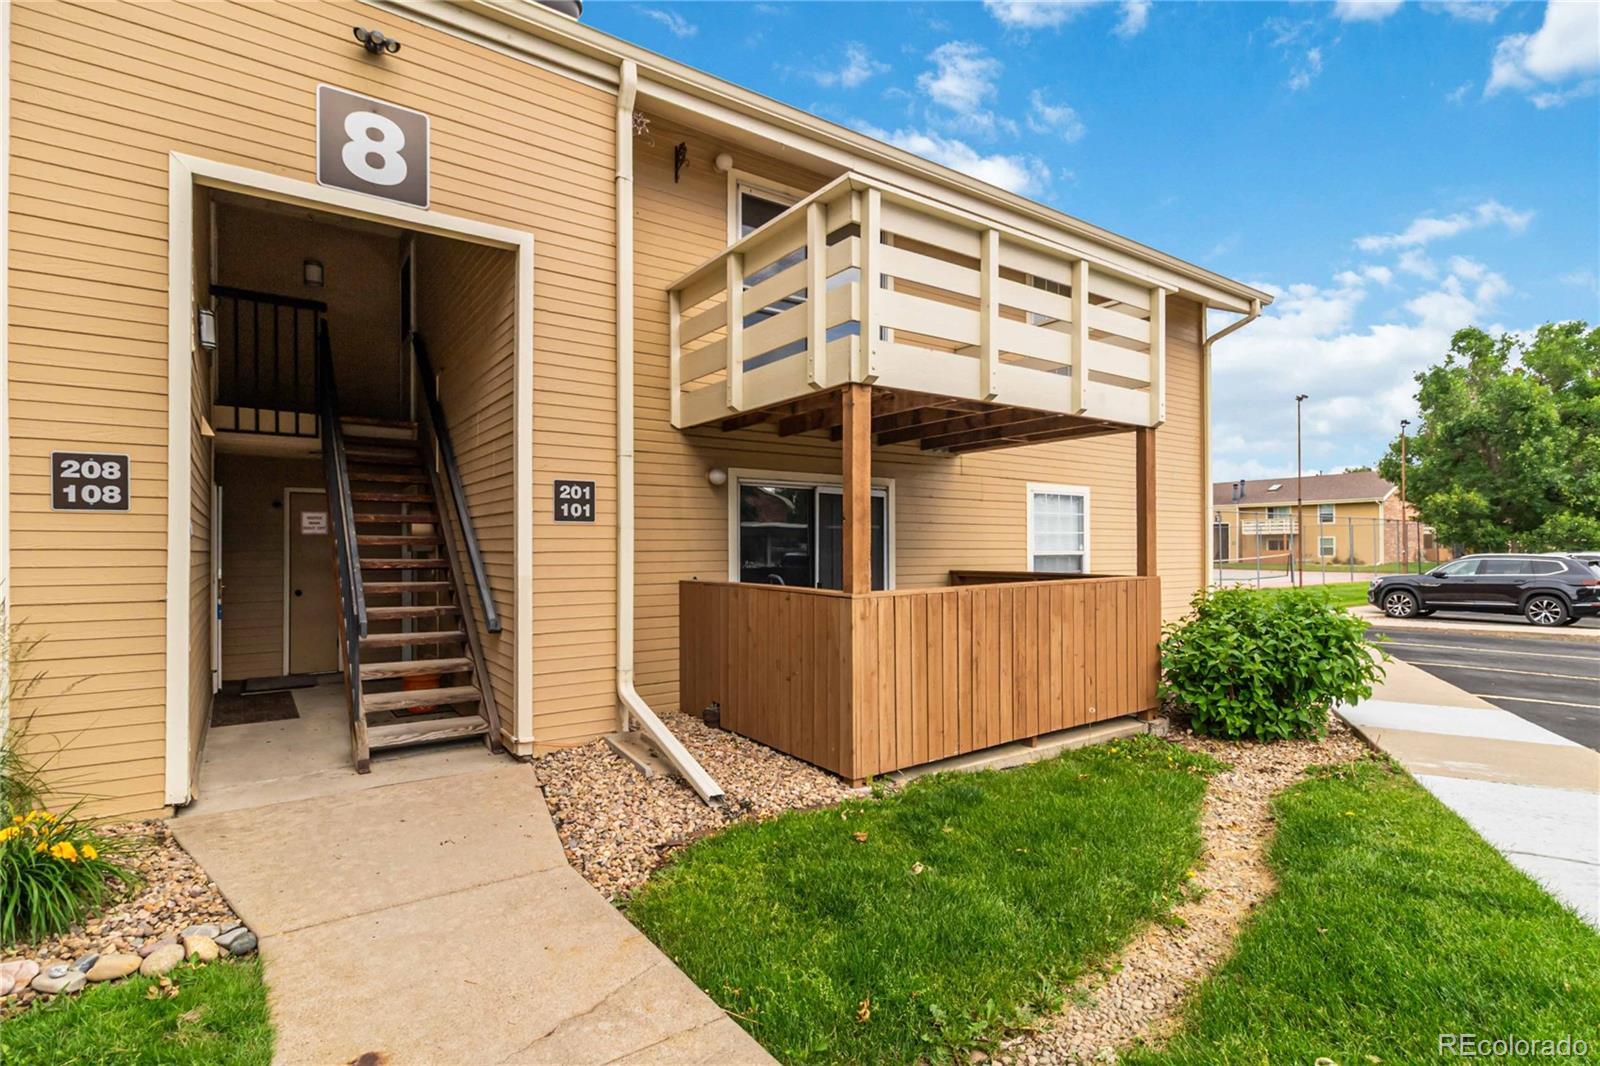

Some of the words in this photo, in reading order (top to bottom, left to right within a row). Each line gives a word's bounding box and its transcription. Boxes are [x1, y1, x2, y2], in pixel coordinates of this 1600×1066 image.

[342, 111, 408, 186] 8
[60, 459, 121, 480] 208
[62, 484, 122, 504] 108
[559, 485, 591, 500] 201
[560, 503, 591, 517] 101
